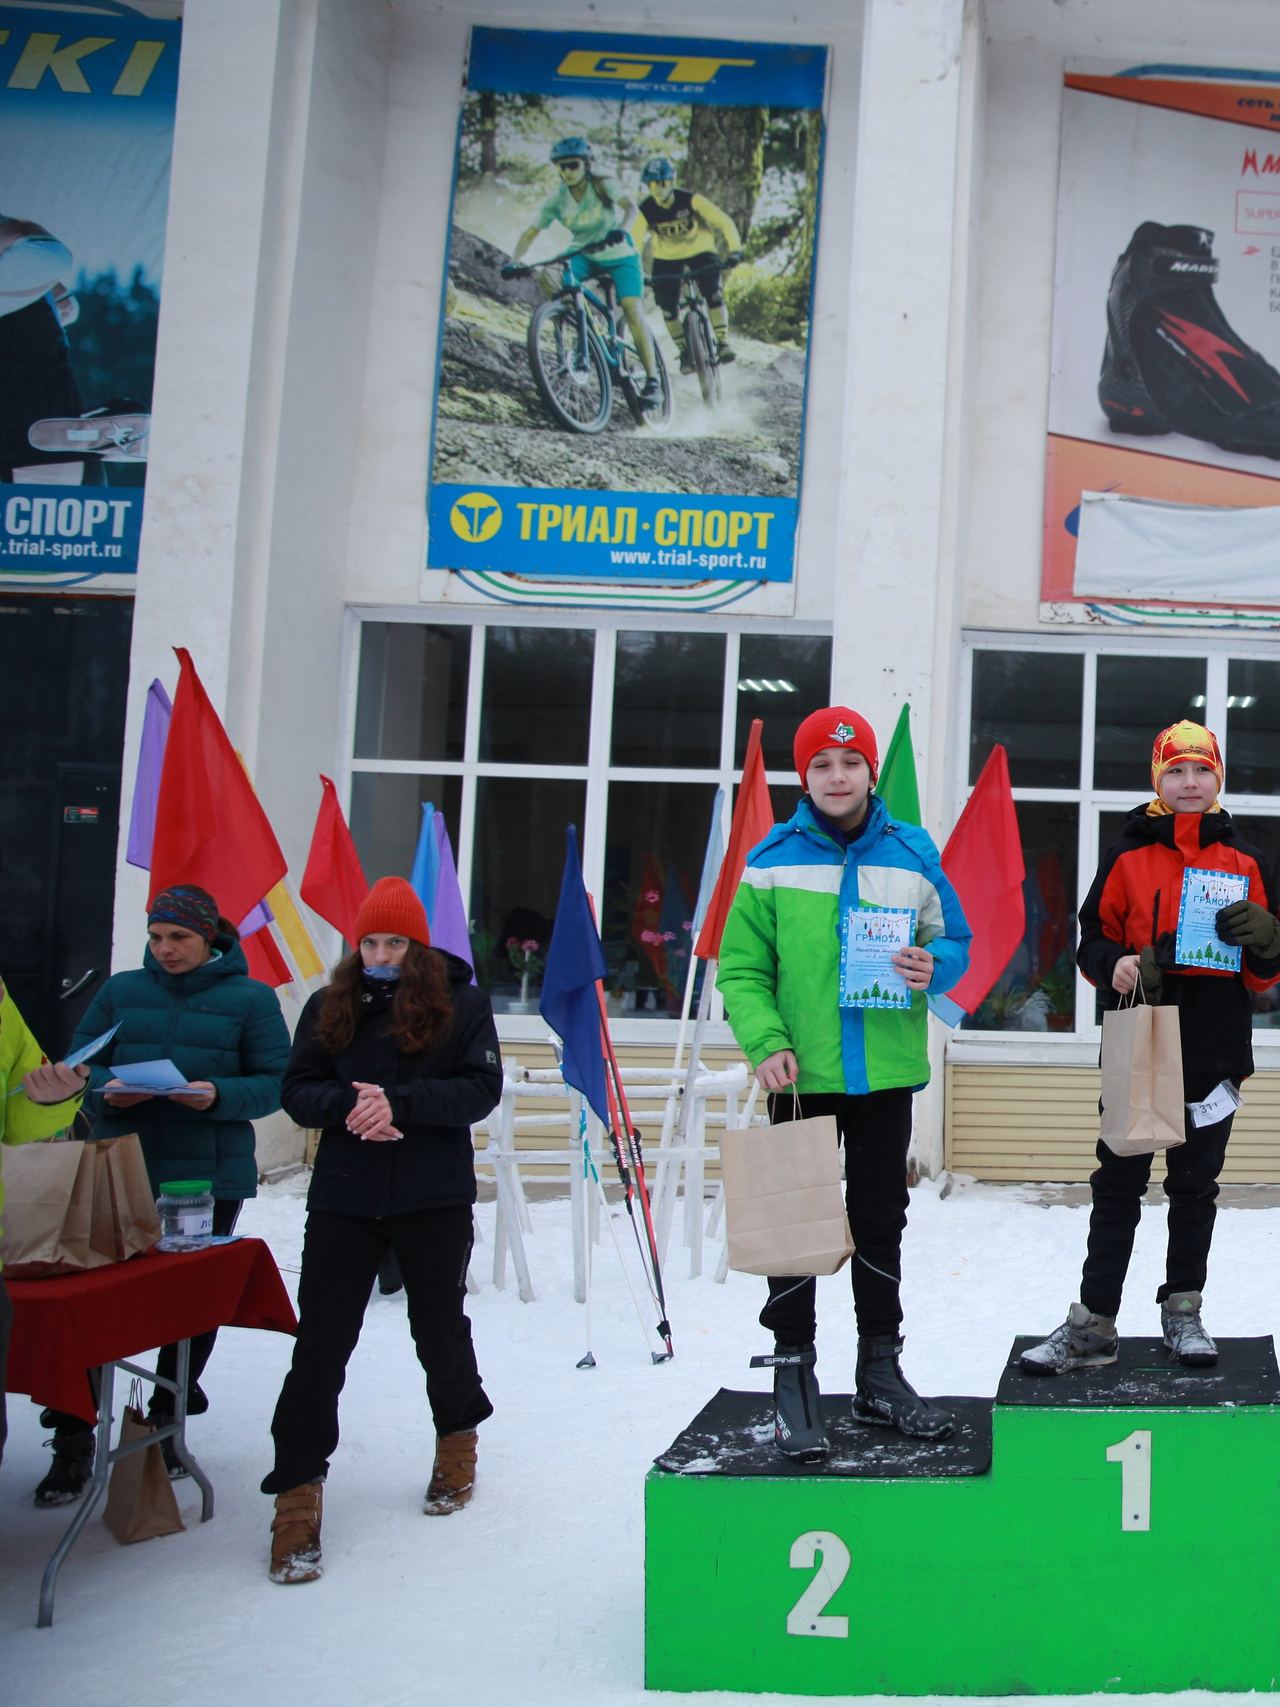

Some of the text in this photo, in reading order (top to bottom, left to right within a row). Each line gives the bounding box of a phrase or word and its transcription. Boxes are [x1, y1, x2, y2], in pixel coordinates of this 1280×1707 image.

[0, 29, 166, 97] KI
[556, 50, 756, 83] GT
[624, 82, 706, 94] BICYCLES
[1236, 97, 1275, 109] сеть
[1270, 260, 1279, 272] В
[5, 496, 132, 538] СПОРТ
[0, 538, 122, 560] .trial-sport.ru
[610, 550, 767, 571] www.trial-sport.ru
[855, 933, 901, 943] ГРАМОТА
[617, 1136, 628, 1169] NORDWAY
[629, 1135, 641, 1167] NORDWAY
[763, 1355, 802, 1365] SPINE
[1106, 1429, 1152, 1532] 1
[786, 1530, 851, 1638] 2
